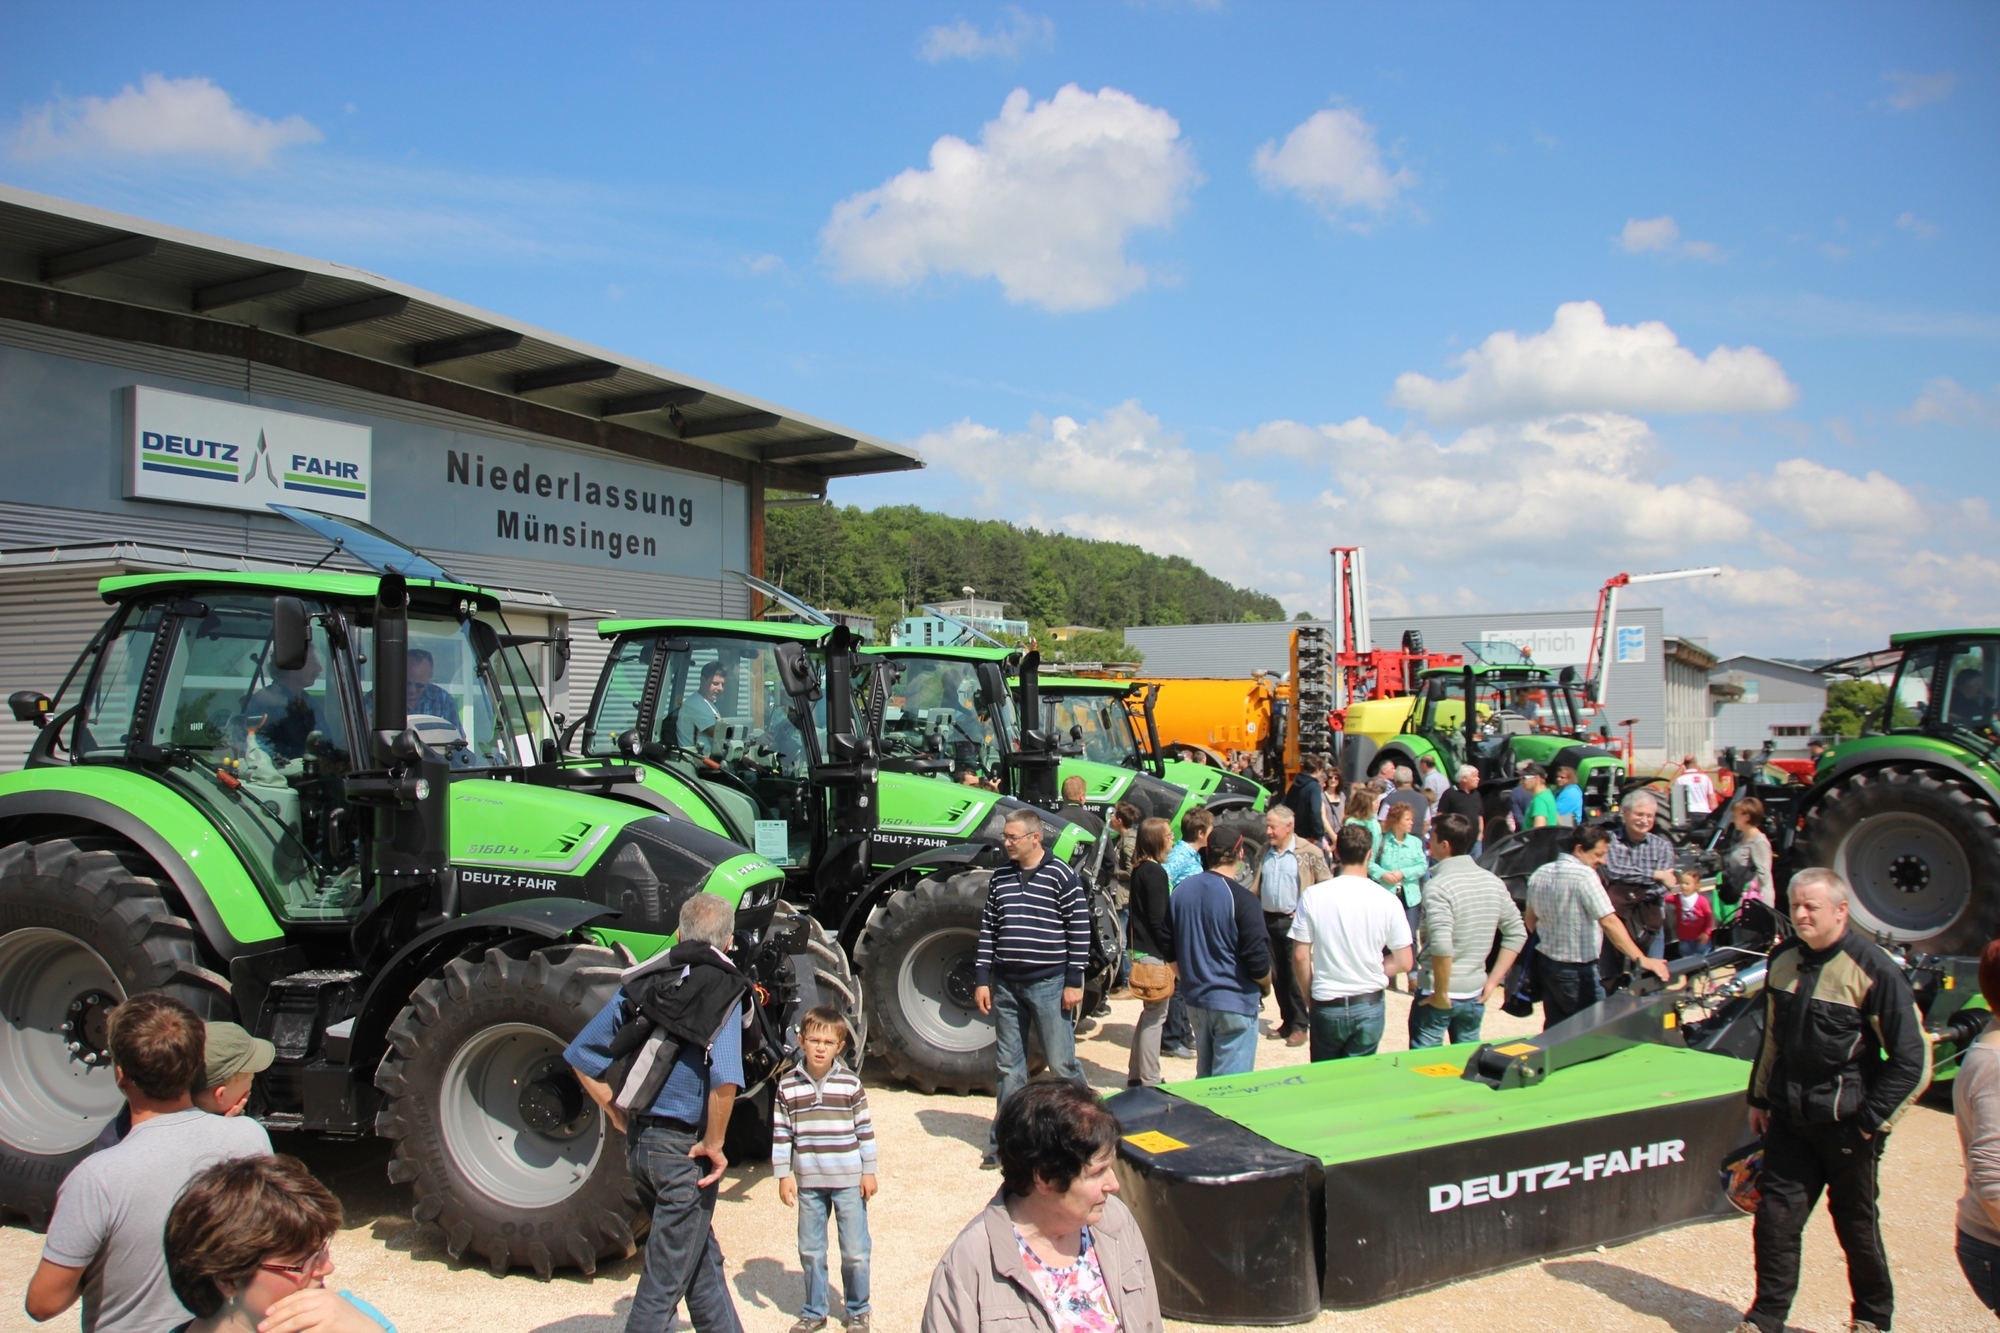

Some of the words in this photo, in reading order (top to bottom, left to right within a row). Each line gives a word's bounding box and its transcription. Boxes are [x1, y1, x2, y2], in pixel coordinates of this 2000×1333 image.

[142, 431, 239, 462] DEUTZ
[292, 454, 358, 480] FAHR
[447, 450, 692, 527] Niederlassung
[497, 509, 656, 559] Münsingen
[1488, 631, 1575, 655] Friedrich
[456, 795, 504, 806] Agrotron
[879, 817, 913, 826] 150.4
[467, 844, 519, 855] 6160.4
[873, 834, 948, 848] DEUTZ-FAHR
[462, 871, 557, 891] DEUTZ-FAHR
[2, 902, 99, 937] RELLEBORG
[1428, 1139, 1685, 1213] DEUTZ-FAHR
